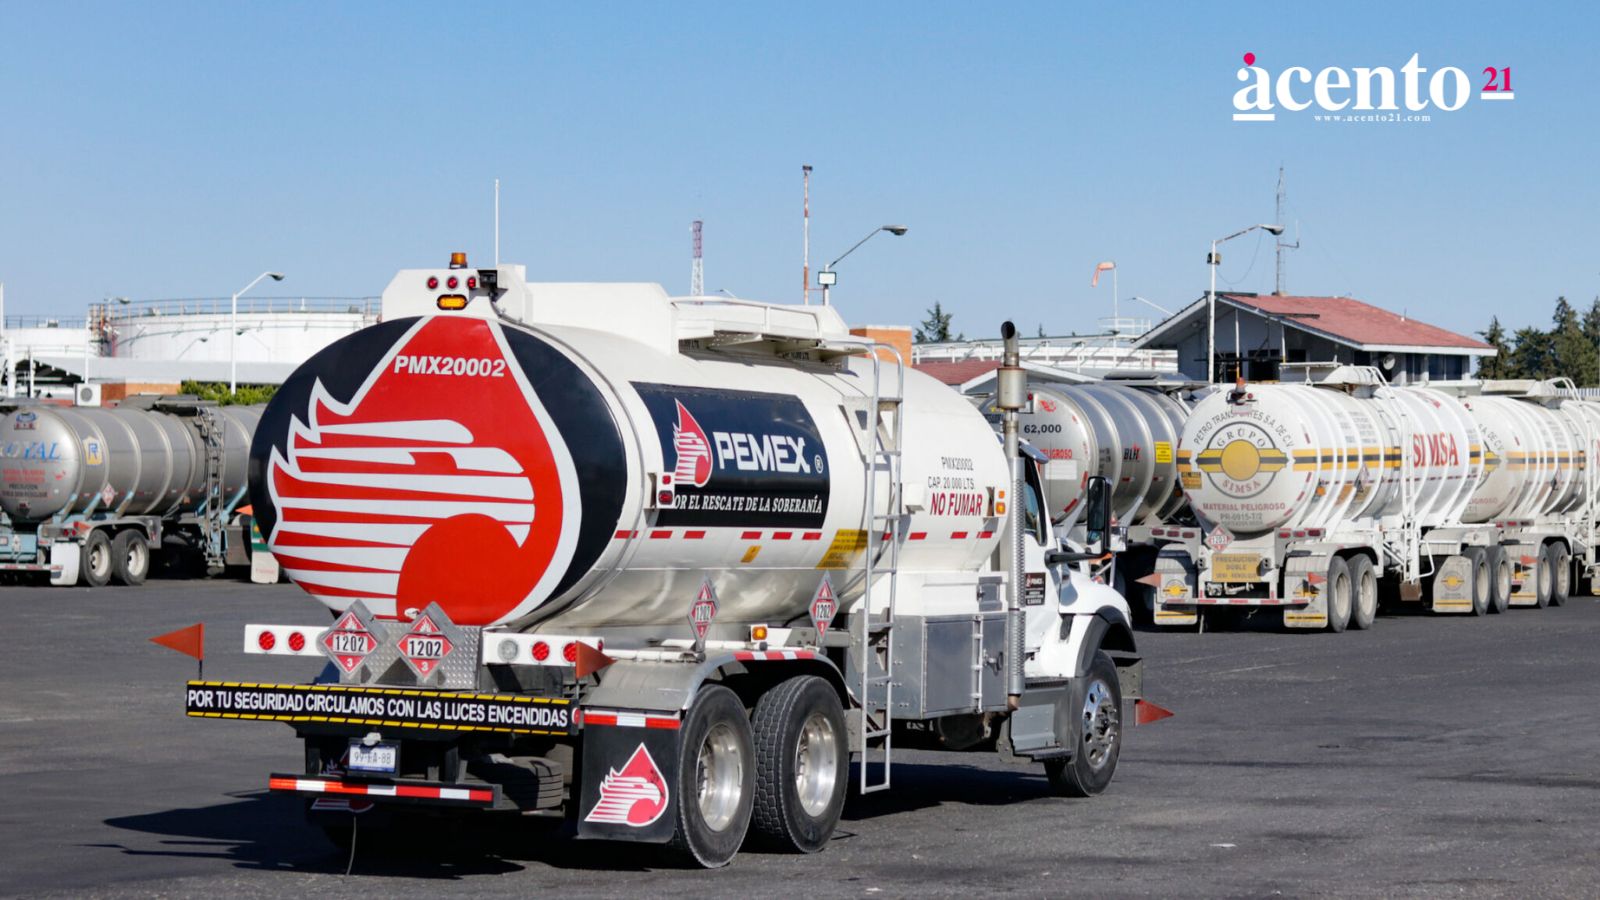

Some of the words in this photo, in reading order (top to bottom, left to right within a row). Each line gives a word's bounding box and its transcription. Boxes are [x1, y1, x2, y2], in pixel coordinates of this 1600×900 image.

[394, 355, 507, 377] PMX20002
[1024, 424, 1062, 434] 62,000
[1194, 421, 1213, 444] PETRO
[1216, 427, 1266, 447] GRUPO
[713, 431, 811, 473] PEMEX
[1412, 431, 1459, 468] SIMSA
[1222, 479, 1261, 493] SIMSA
[688, 495, 701, 510] EL
[702, 495, 744, 512] RESCATE
[745, 497, 758, 512] DE
[758, 497, 771, 512] LA
[772, 494, 822, 513] SOBERANÍA
[930, 492, 946, 516] NO
[947, 492, 983, 516] FUMAR
[1202, 502, 1238, 511] MATERIAL
[1241, 502, 1286, 511] PELIGROSO
[335, 636, 365, 652] 1202
[409, 640, 442, 657] 1202
[346, 657, 353, 668] 3
[421, 660, 429, 672] 3
[188, 690, 214, 708] POR
[216, 691, 232, 709] TU
[234, 692, 304, 712] SEGURIDAD
[305, 693, 385, 716] CIRCULAMOS
[387, 698, 414, 718] CON
[417, 700, 442, 720] LAS
[444, 702, 485, 722] LUCES
[487, 706, 568, 727] ENCENDIDAS
